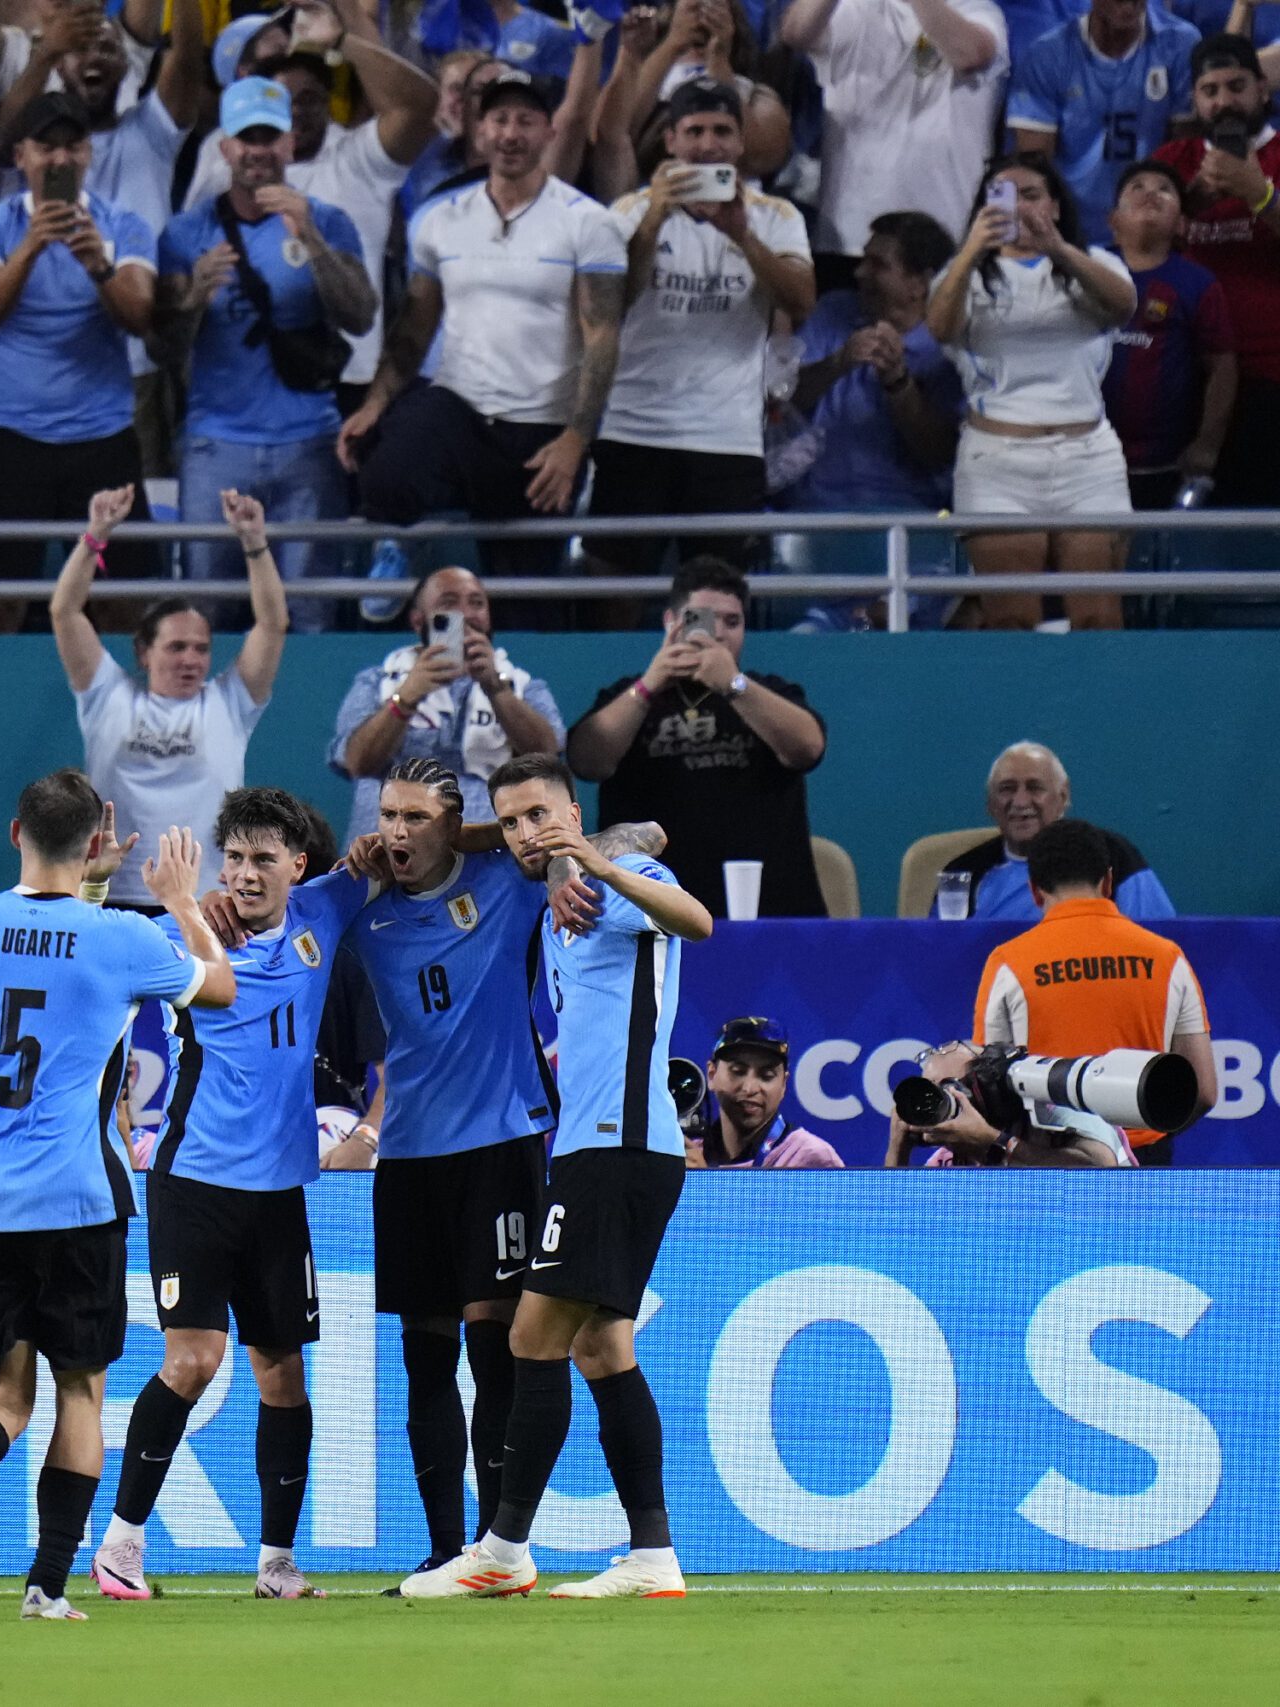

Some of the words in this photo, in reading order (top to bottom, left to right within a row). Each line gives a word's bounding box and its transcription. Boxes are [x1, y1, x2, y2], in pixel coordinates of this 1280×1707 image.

[417, 964, 452, 1015] 19
[1033, 955, 1154, 987] SECURITY
[269, 1000, 296, 1049] 11
[495, 1211, 527, 1261] 19
[541, 1203, 566, 1253] 6
